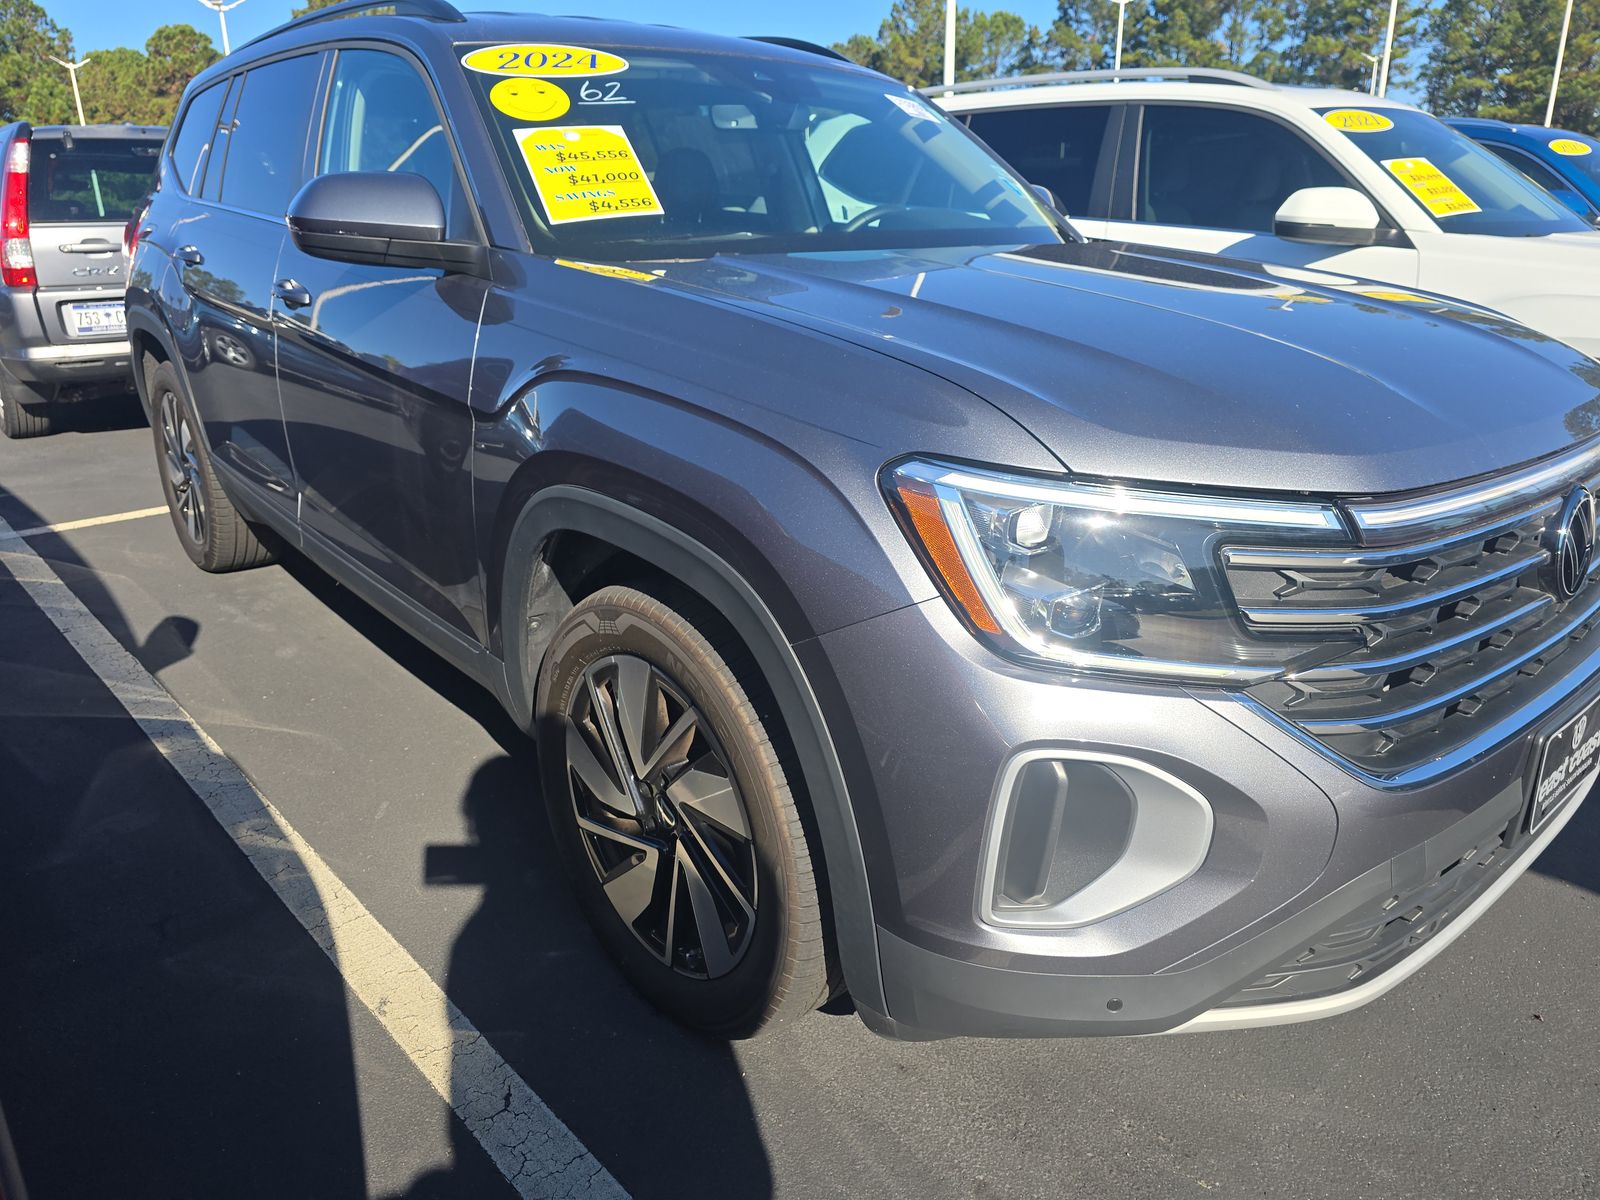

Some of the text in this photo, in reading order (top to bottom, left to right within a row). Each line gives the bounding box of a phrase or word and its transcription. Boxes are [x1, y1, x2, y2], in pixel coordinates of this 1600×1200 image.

[497, 52, 602, 70] 2024
[579, 80, 628, 101] 62
[534, 143, 566, 151] WAS
[555, 149, 629, 163] $45,556
[544, 165, 577, 174] NOW
[568, 171, 639, 186] $41,000
[555, 190, 616, 201] SAVINGS
[588, 197, 652, 212] $4,556
[76, 311, 101, 327] 753
[1538, 755, 1570, 803] east
